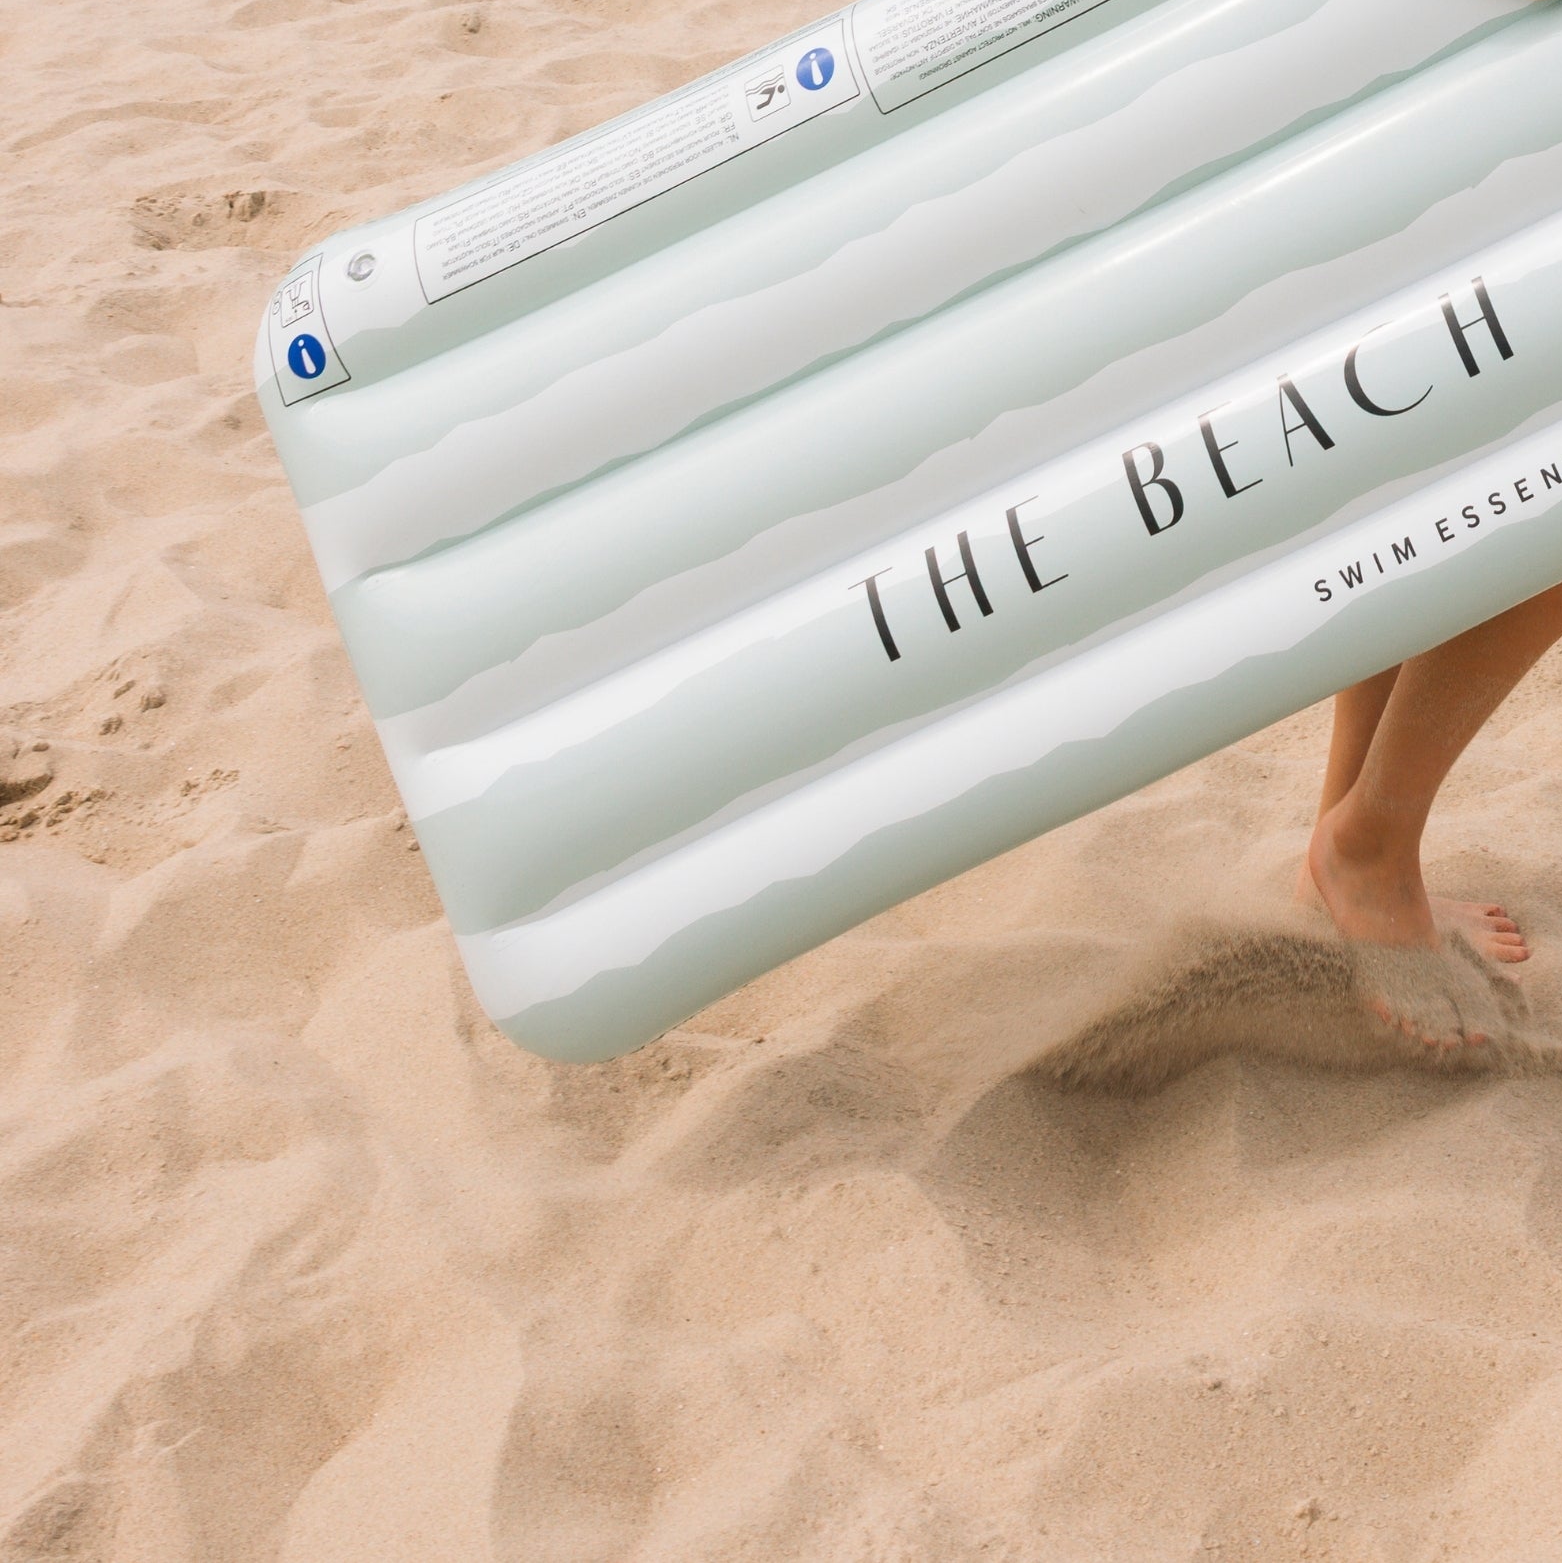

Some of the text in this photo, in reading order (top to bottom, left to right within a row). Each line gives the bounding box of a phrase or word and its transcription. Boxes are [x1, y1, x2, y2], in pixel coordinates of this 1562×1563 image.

[977, 13, 987, 23] IT
[1004, 25, 1018, 36] NOT
[976, 32, 1005, 50] PROTECT
[951, 46, 977, 63] AGAINST
[848, 494, 1069, 662] THE
[1121, 276, 1515, 537] BEACH
[1313, 535, 1418, 603] SWIM
